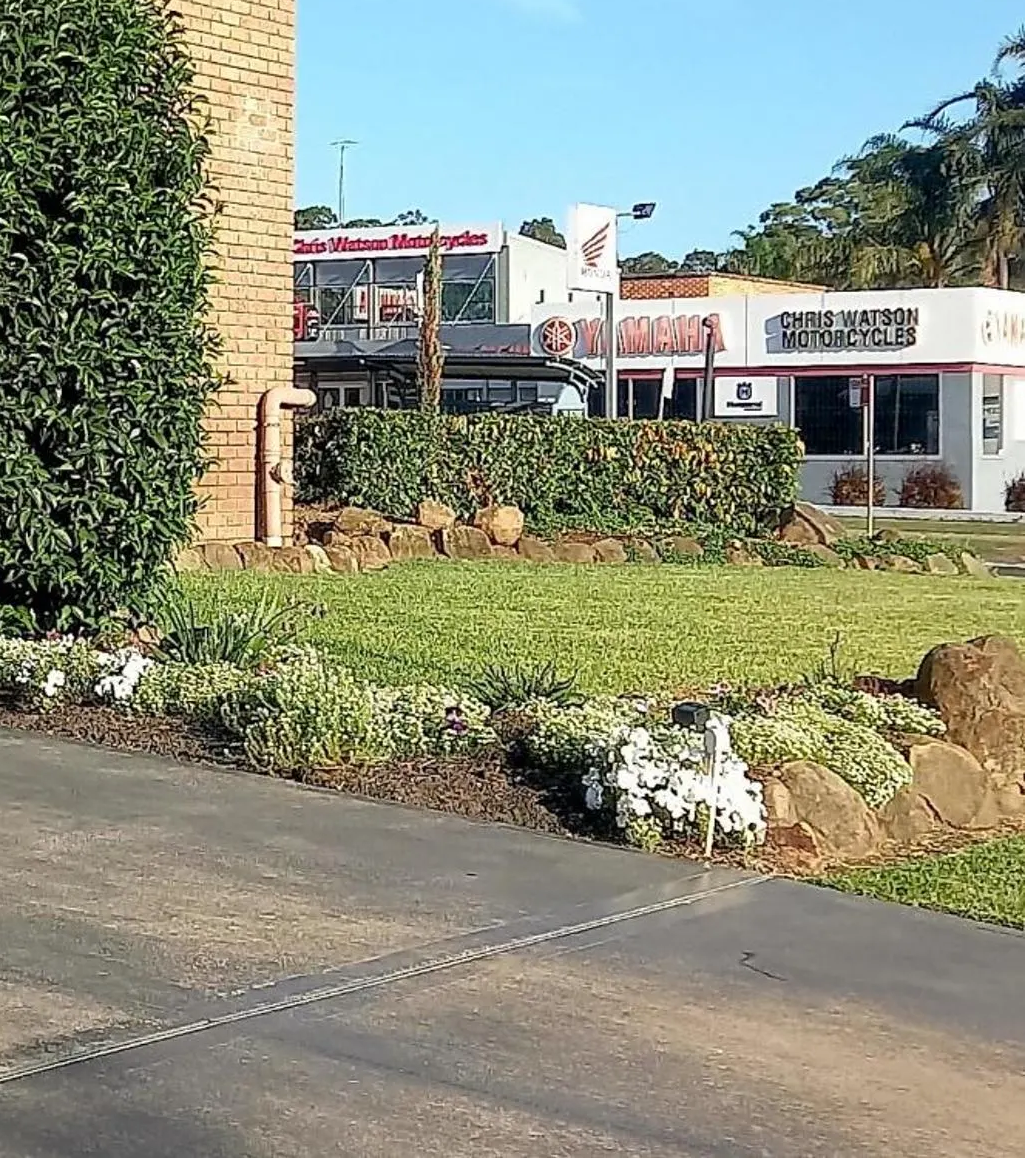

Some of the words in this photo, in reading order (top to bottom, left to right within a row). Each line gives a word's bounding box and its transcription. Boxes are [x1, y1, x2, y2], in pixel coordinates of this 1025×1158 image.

[328, 236, 388, 252] Watson
[389, 230, 488, 250] Motocycles
[780, 311, 834, 328] CHRIS
[840, 307, 919, 328] WATSON
[781, 327, 917, 349] MOTORCYCLES
